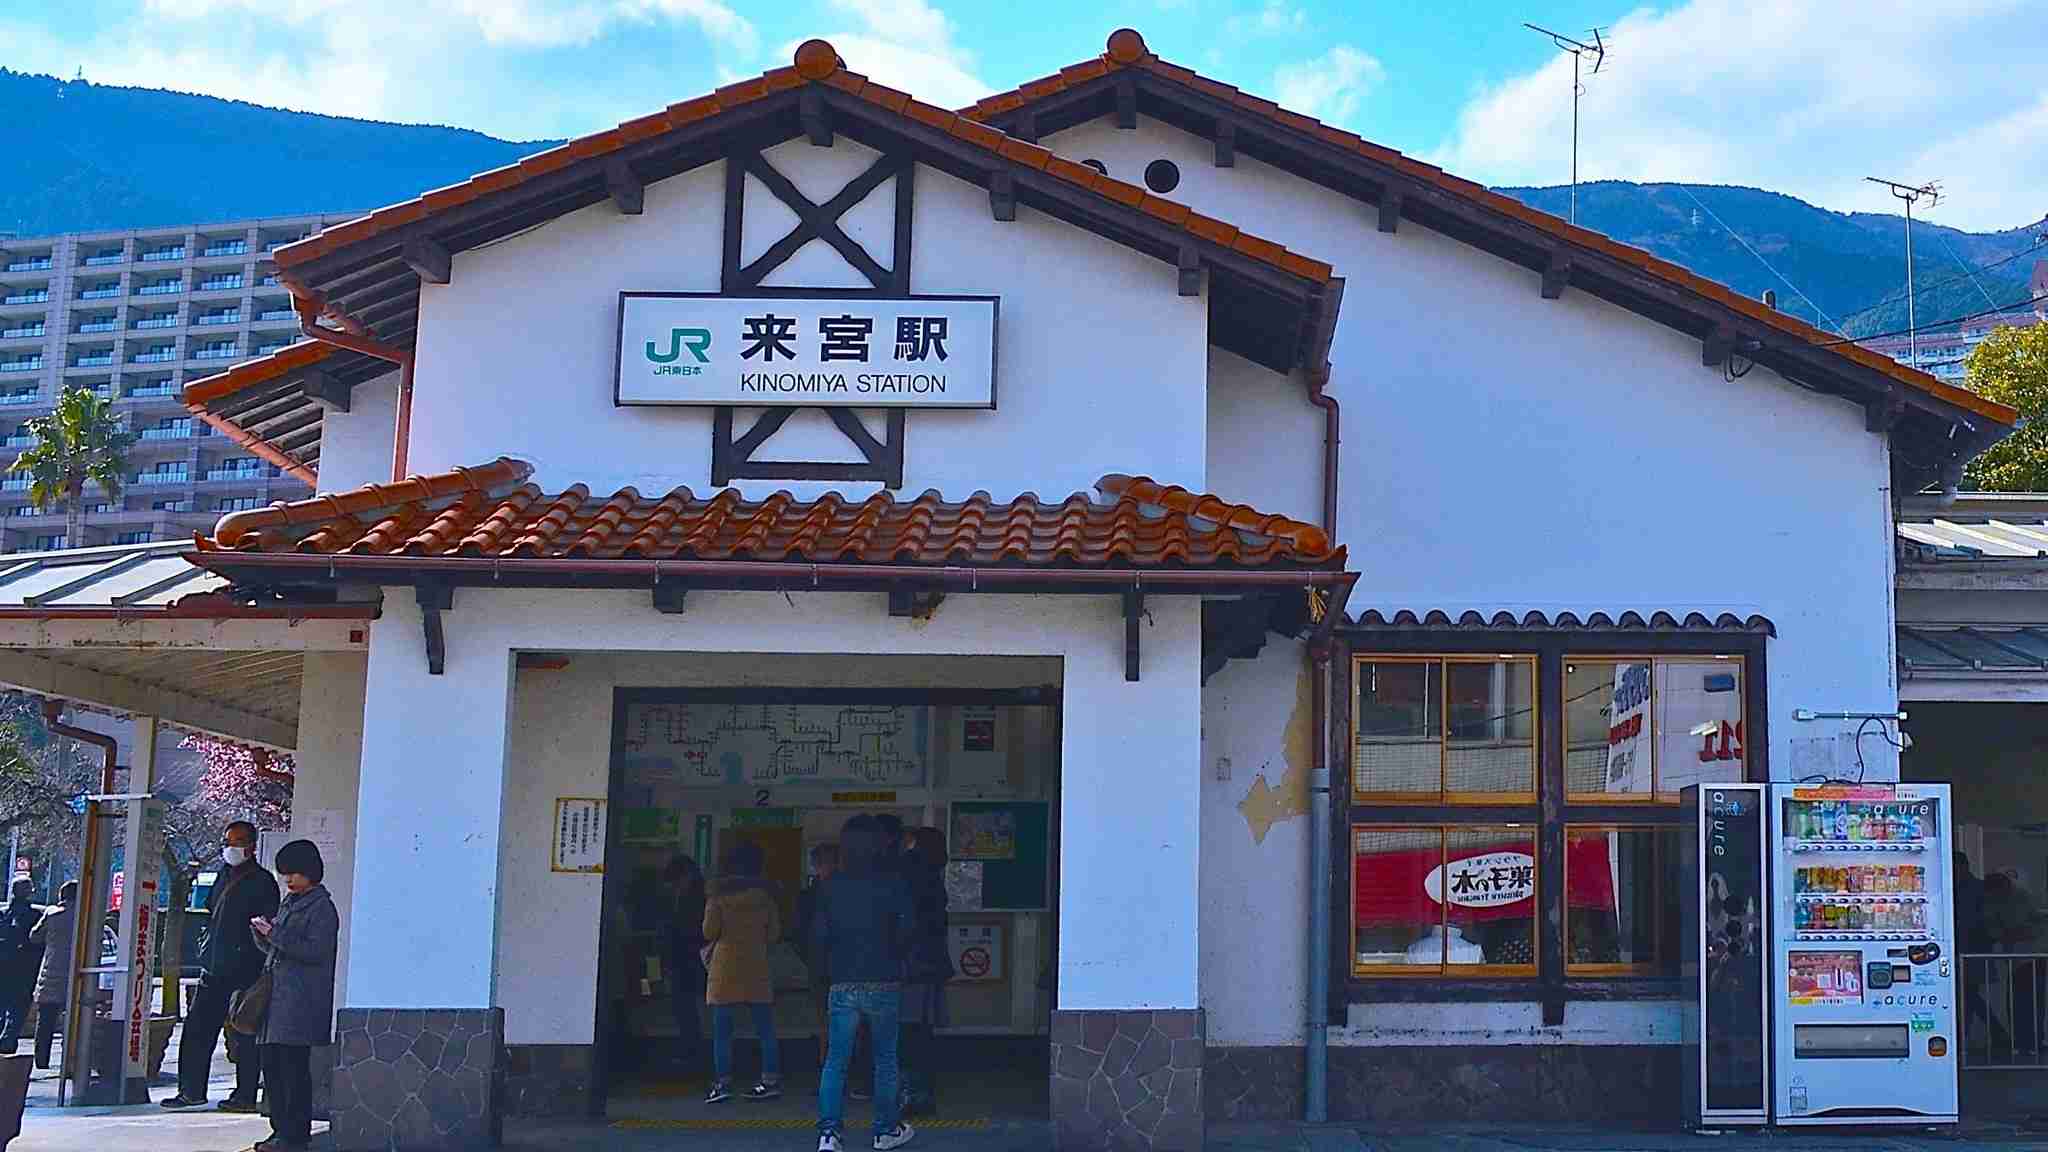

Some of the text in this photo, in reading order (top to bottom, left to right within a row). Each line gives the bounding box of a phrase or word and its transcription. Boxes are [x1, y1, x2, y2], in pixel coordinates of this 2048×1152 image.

[646, 327, 713, 364] JR
[740, 312, 949, 363] 来宮駅
[653, 365, 703, 377] JR東日本
[741, 374, 947, 394] KINOMIYA STATION
[756, 789, 770, 807] 2
[1712, 791, 1726, 857] acure
[1884, 993, 1938, 1006] acure
